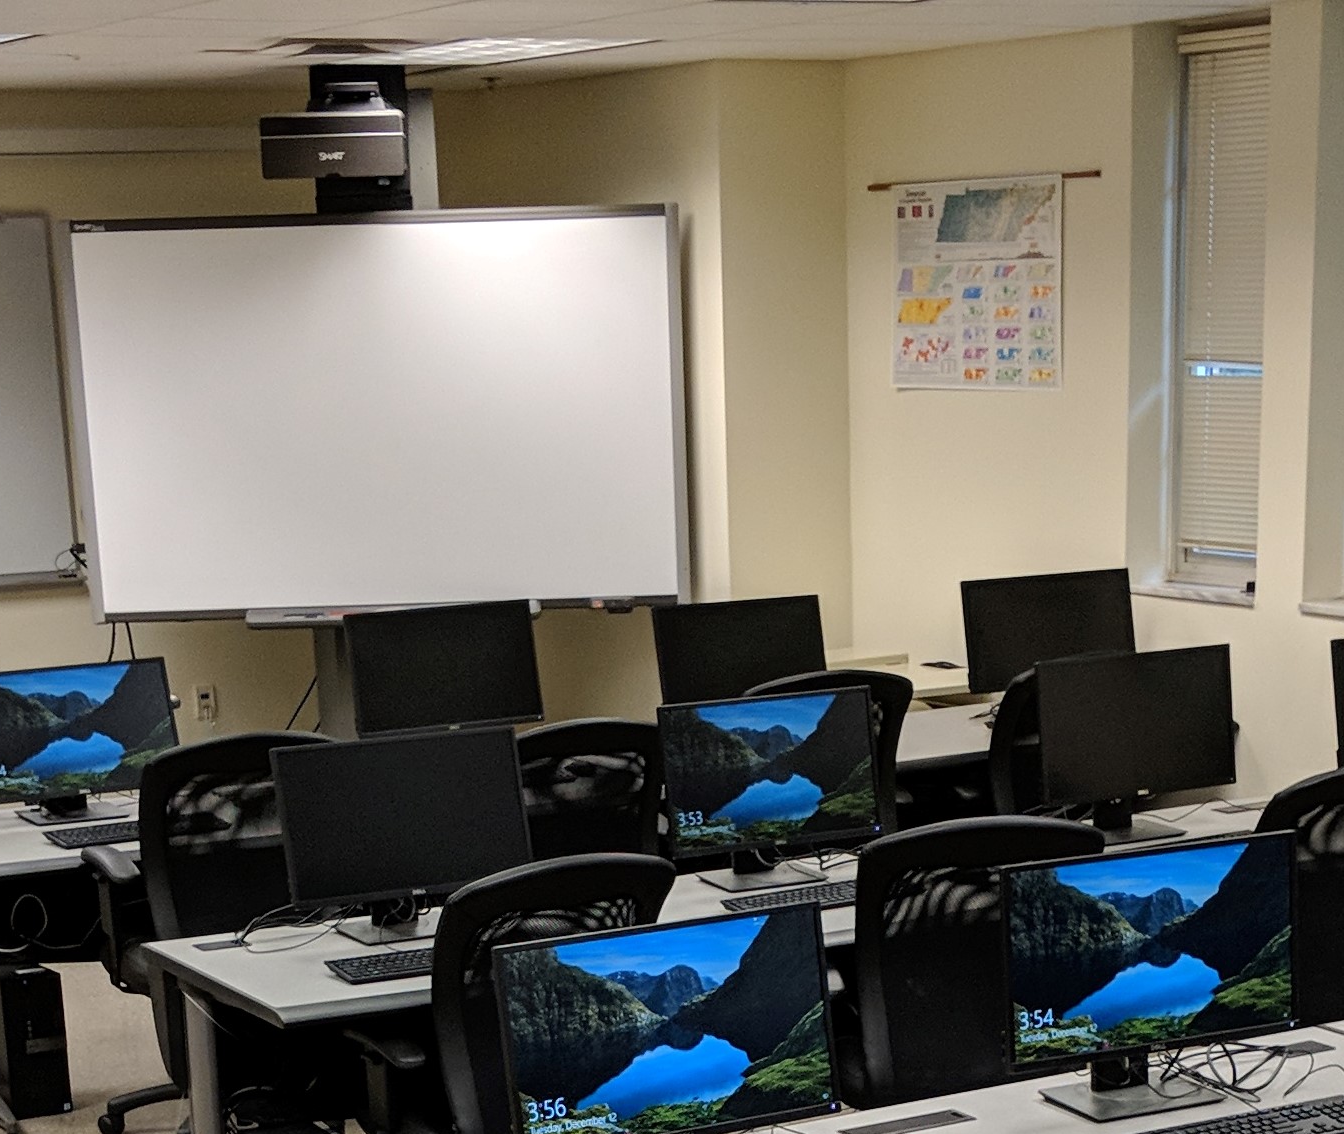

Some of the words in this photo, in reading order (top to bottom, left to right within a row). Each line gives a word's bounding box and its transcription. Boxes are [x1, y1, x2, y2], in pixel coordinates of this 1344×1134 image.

[677, 810, 704, 828] 3:53
[1018, 1007, 1055, 1031] 3:54
[527, 1096, 567, 1123] 3:56
[565, 1115, 607, 1132] December
